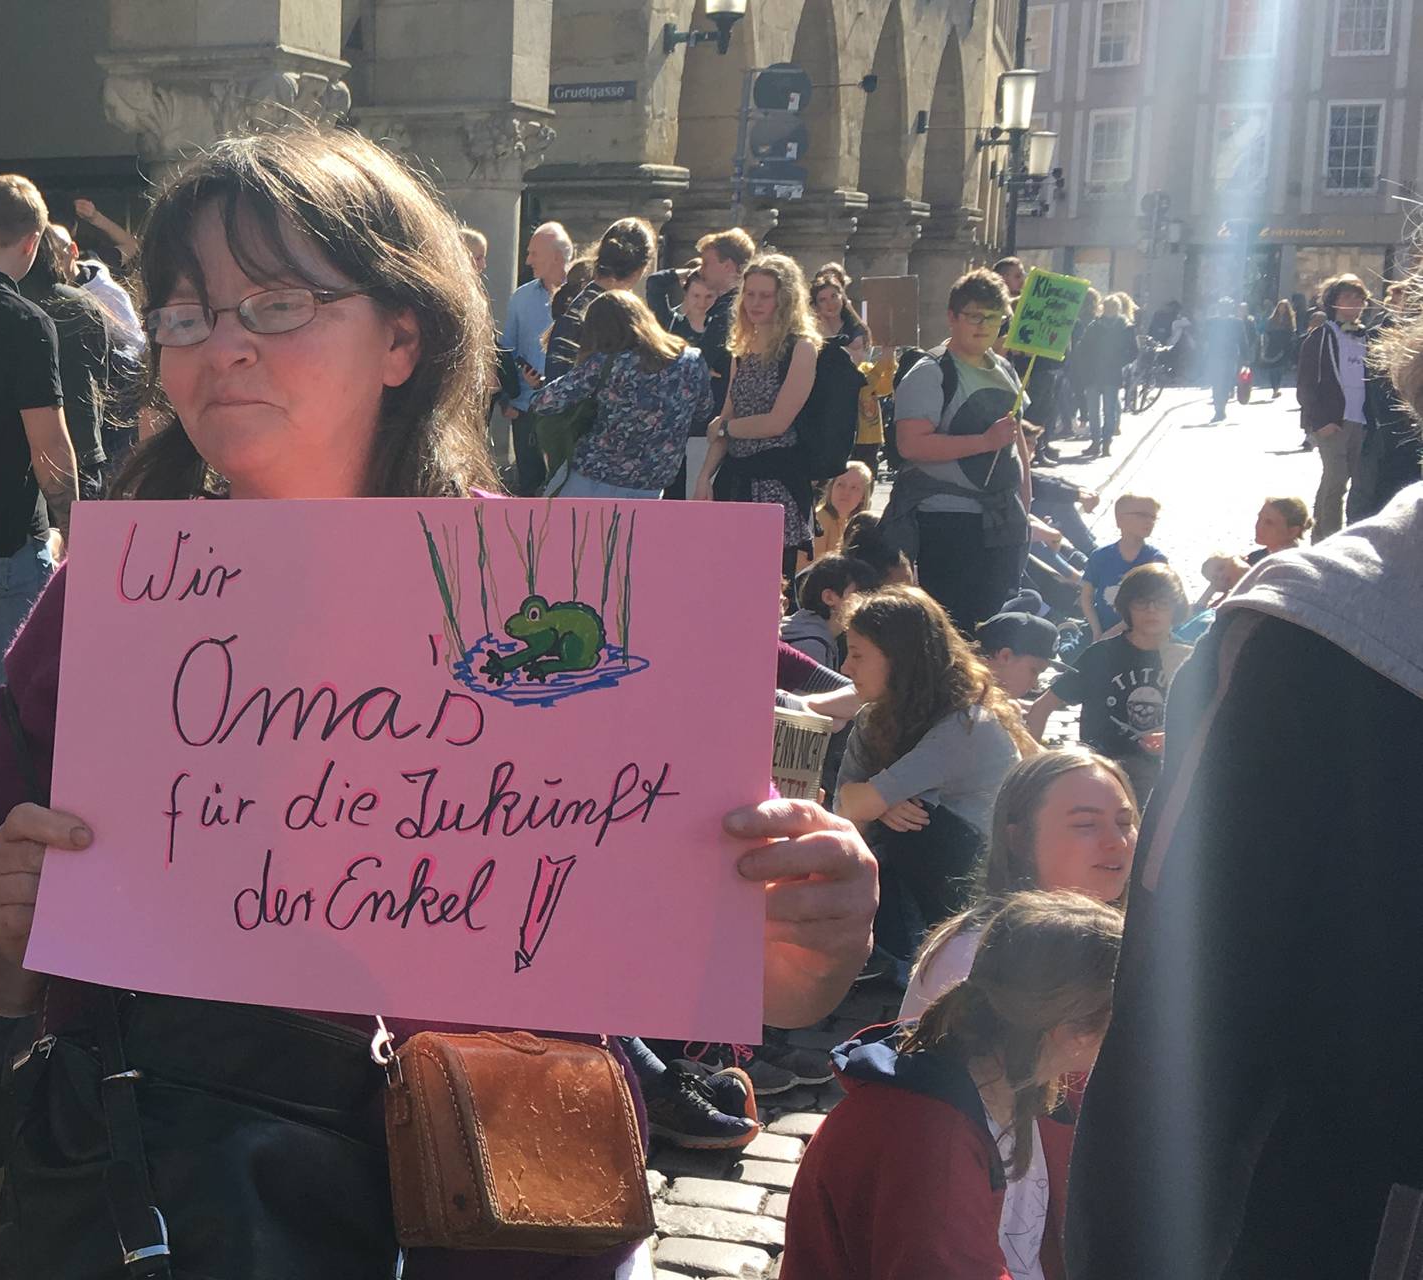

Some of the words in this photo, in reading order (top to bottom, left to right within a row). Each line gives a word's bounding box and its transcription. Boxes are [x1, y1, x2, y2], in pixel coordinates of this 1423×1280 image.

[117, 521, 242, 604] Wir
[1111, 667, 1170, 690] TITU
[163, 770, 256, 870] für
[284, 760, 379, 831] die
[234, 849, 316, 931] der
